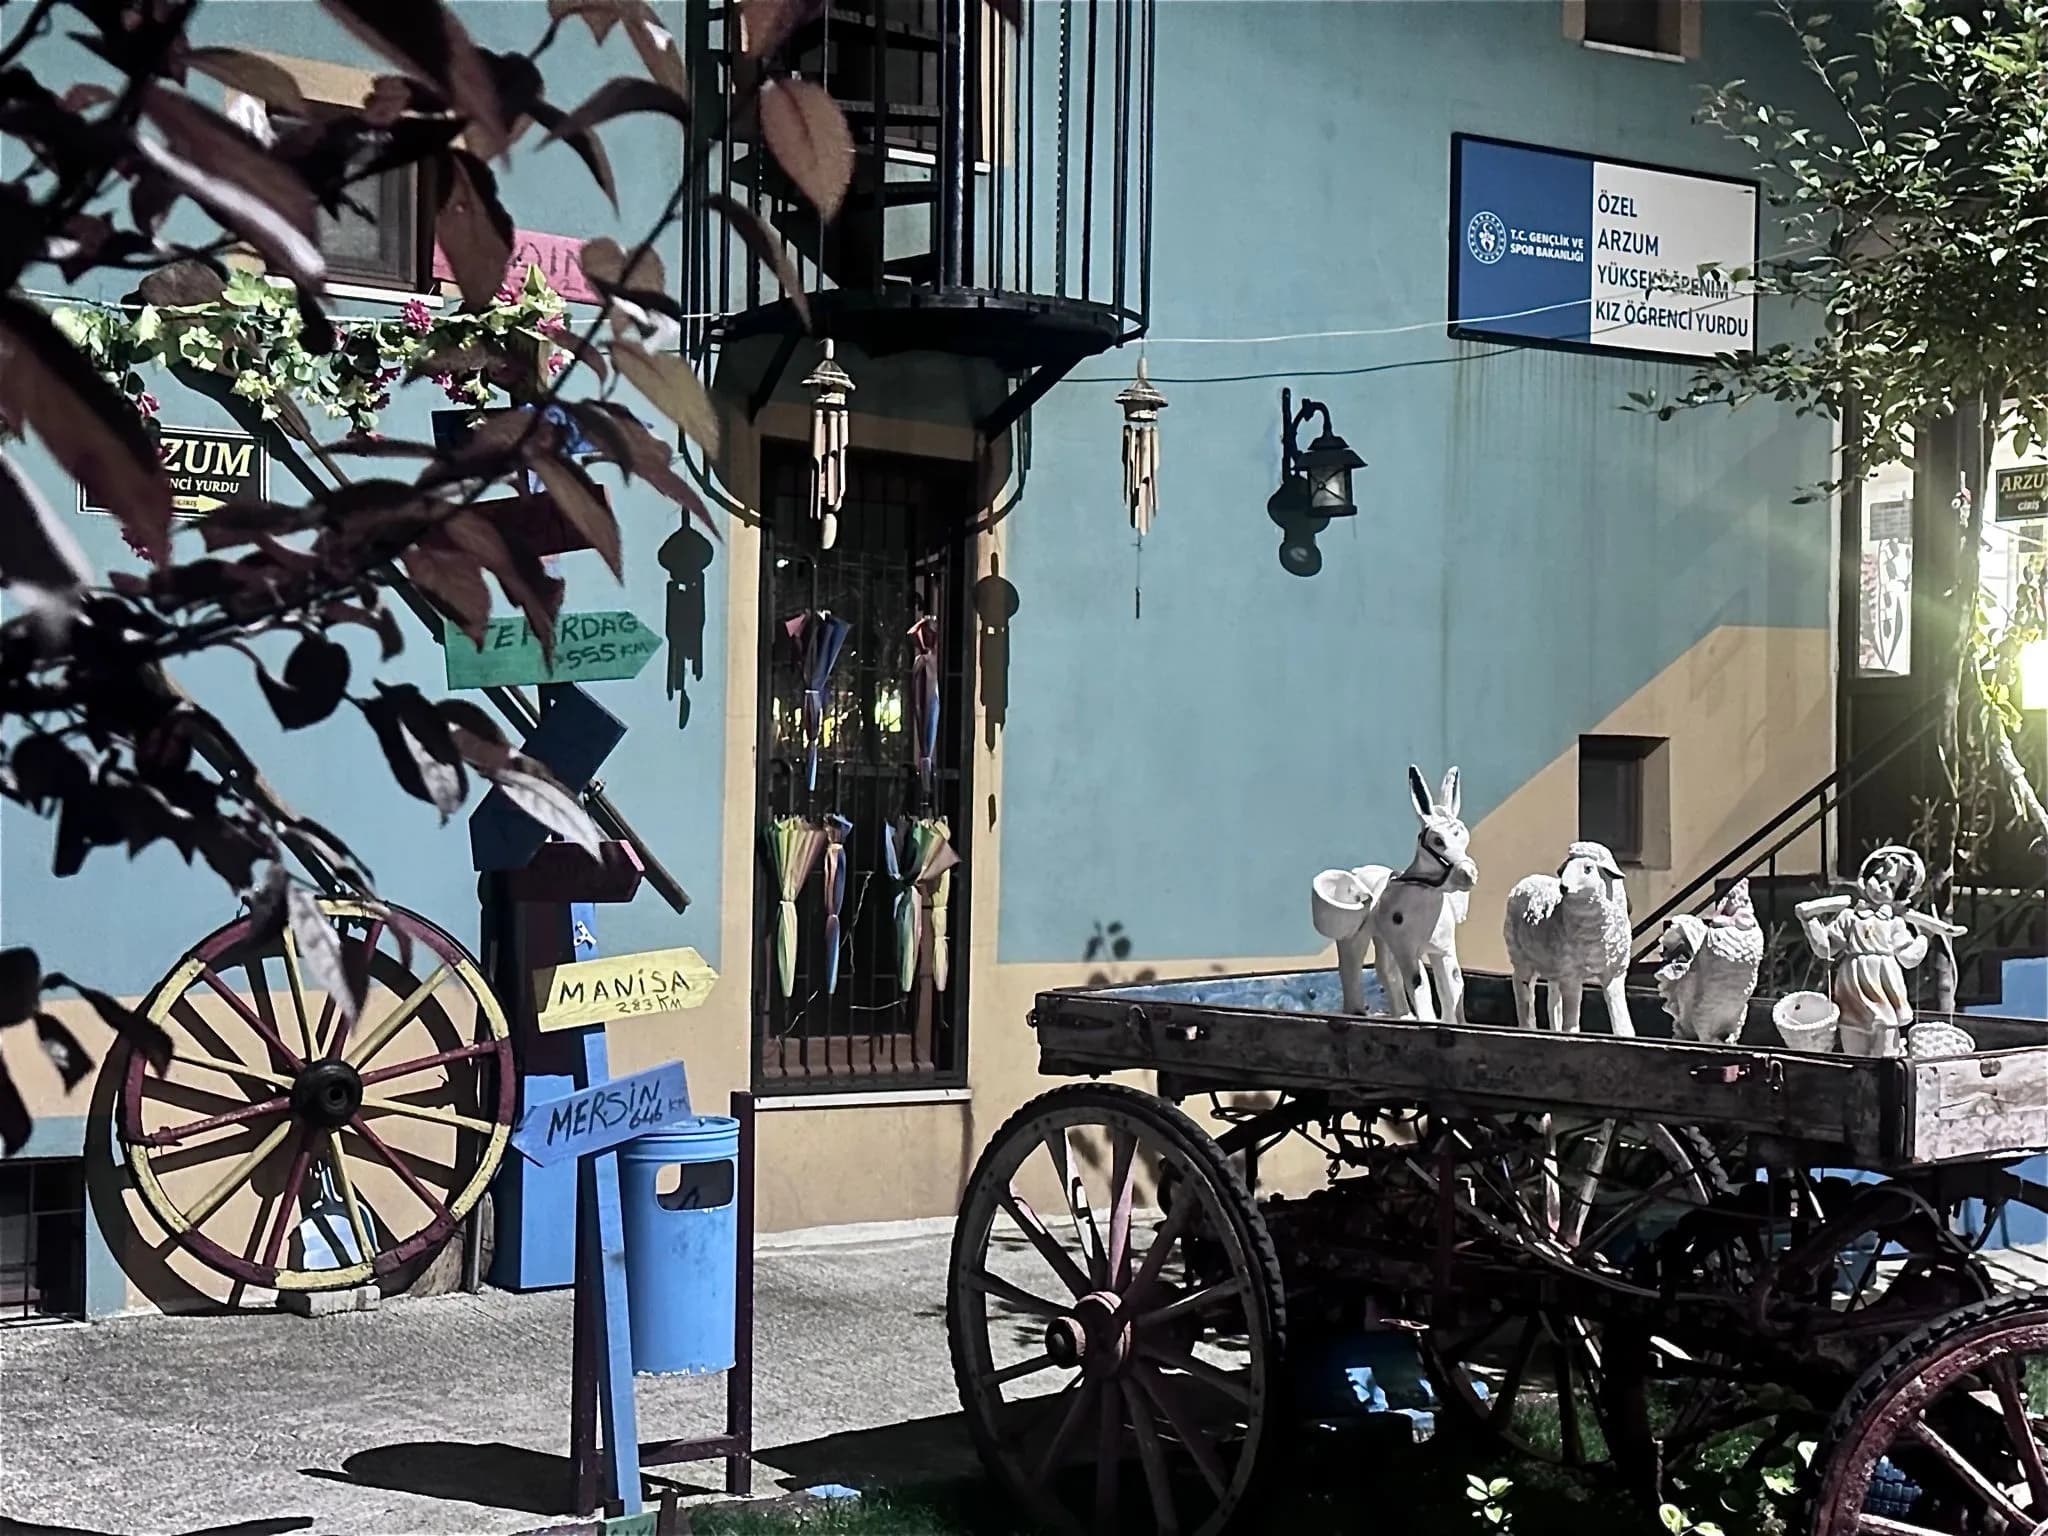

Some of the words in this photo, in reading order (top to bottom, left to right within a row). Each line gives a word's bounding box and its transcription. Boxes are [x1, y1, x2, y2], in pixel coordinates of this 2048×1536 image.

[1597, 189, 1638, 218] ÖZEL
[1510, 229, 1528, 241] T.C.
[1529, 232, 1570, 247] GENÇLİK
[1571, 238, 1584, 249] VE
[1597, 228, 1659, 257] ARZUM
[1510, 243, 1535, 256] SPOR
[1535, 246, 1584, 263] BAKANLIĞI
[1596, 300, 1621, 322] KIZ
[1624, 300, 1693, 331] ÖĞRENCİ
[1695, 312, 1749, 338] YURDU
[159, 437, 256, 478] ZUM
[194, 479, 240, 494] YURDU
[2000, 472, 2048, 493] ARZU
[620, 641, 649, 659] KM
[558, 968, 690, 1005] MANİSA
[615, 997, 654, 1014] 283
[655, 994, 683, 1013] KM
[546, 1079, 660, 1146] MERSİN
